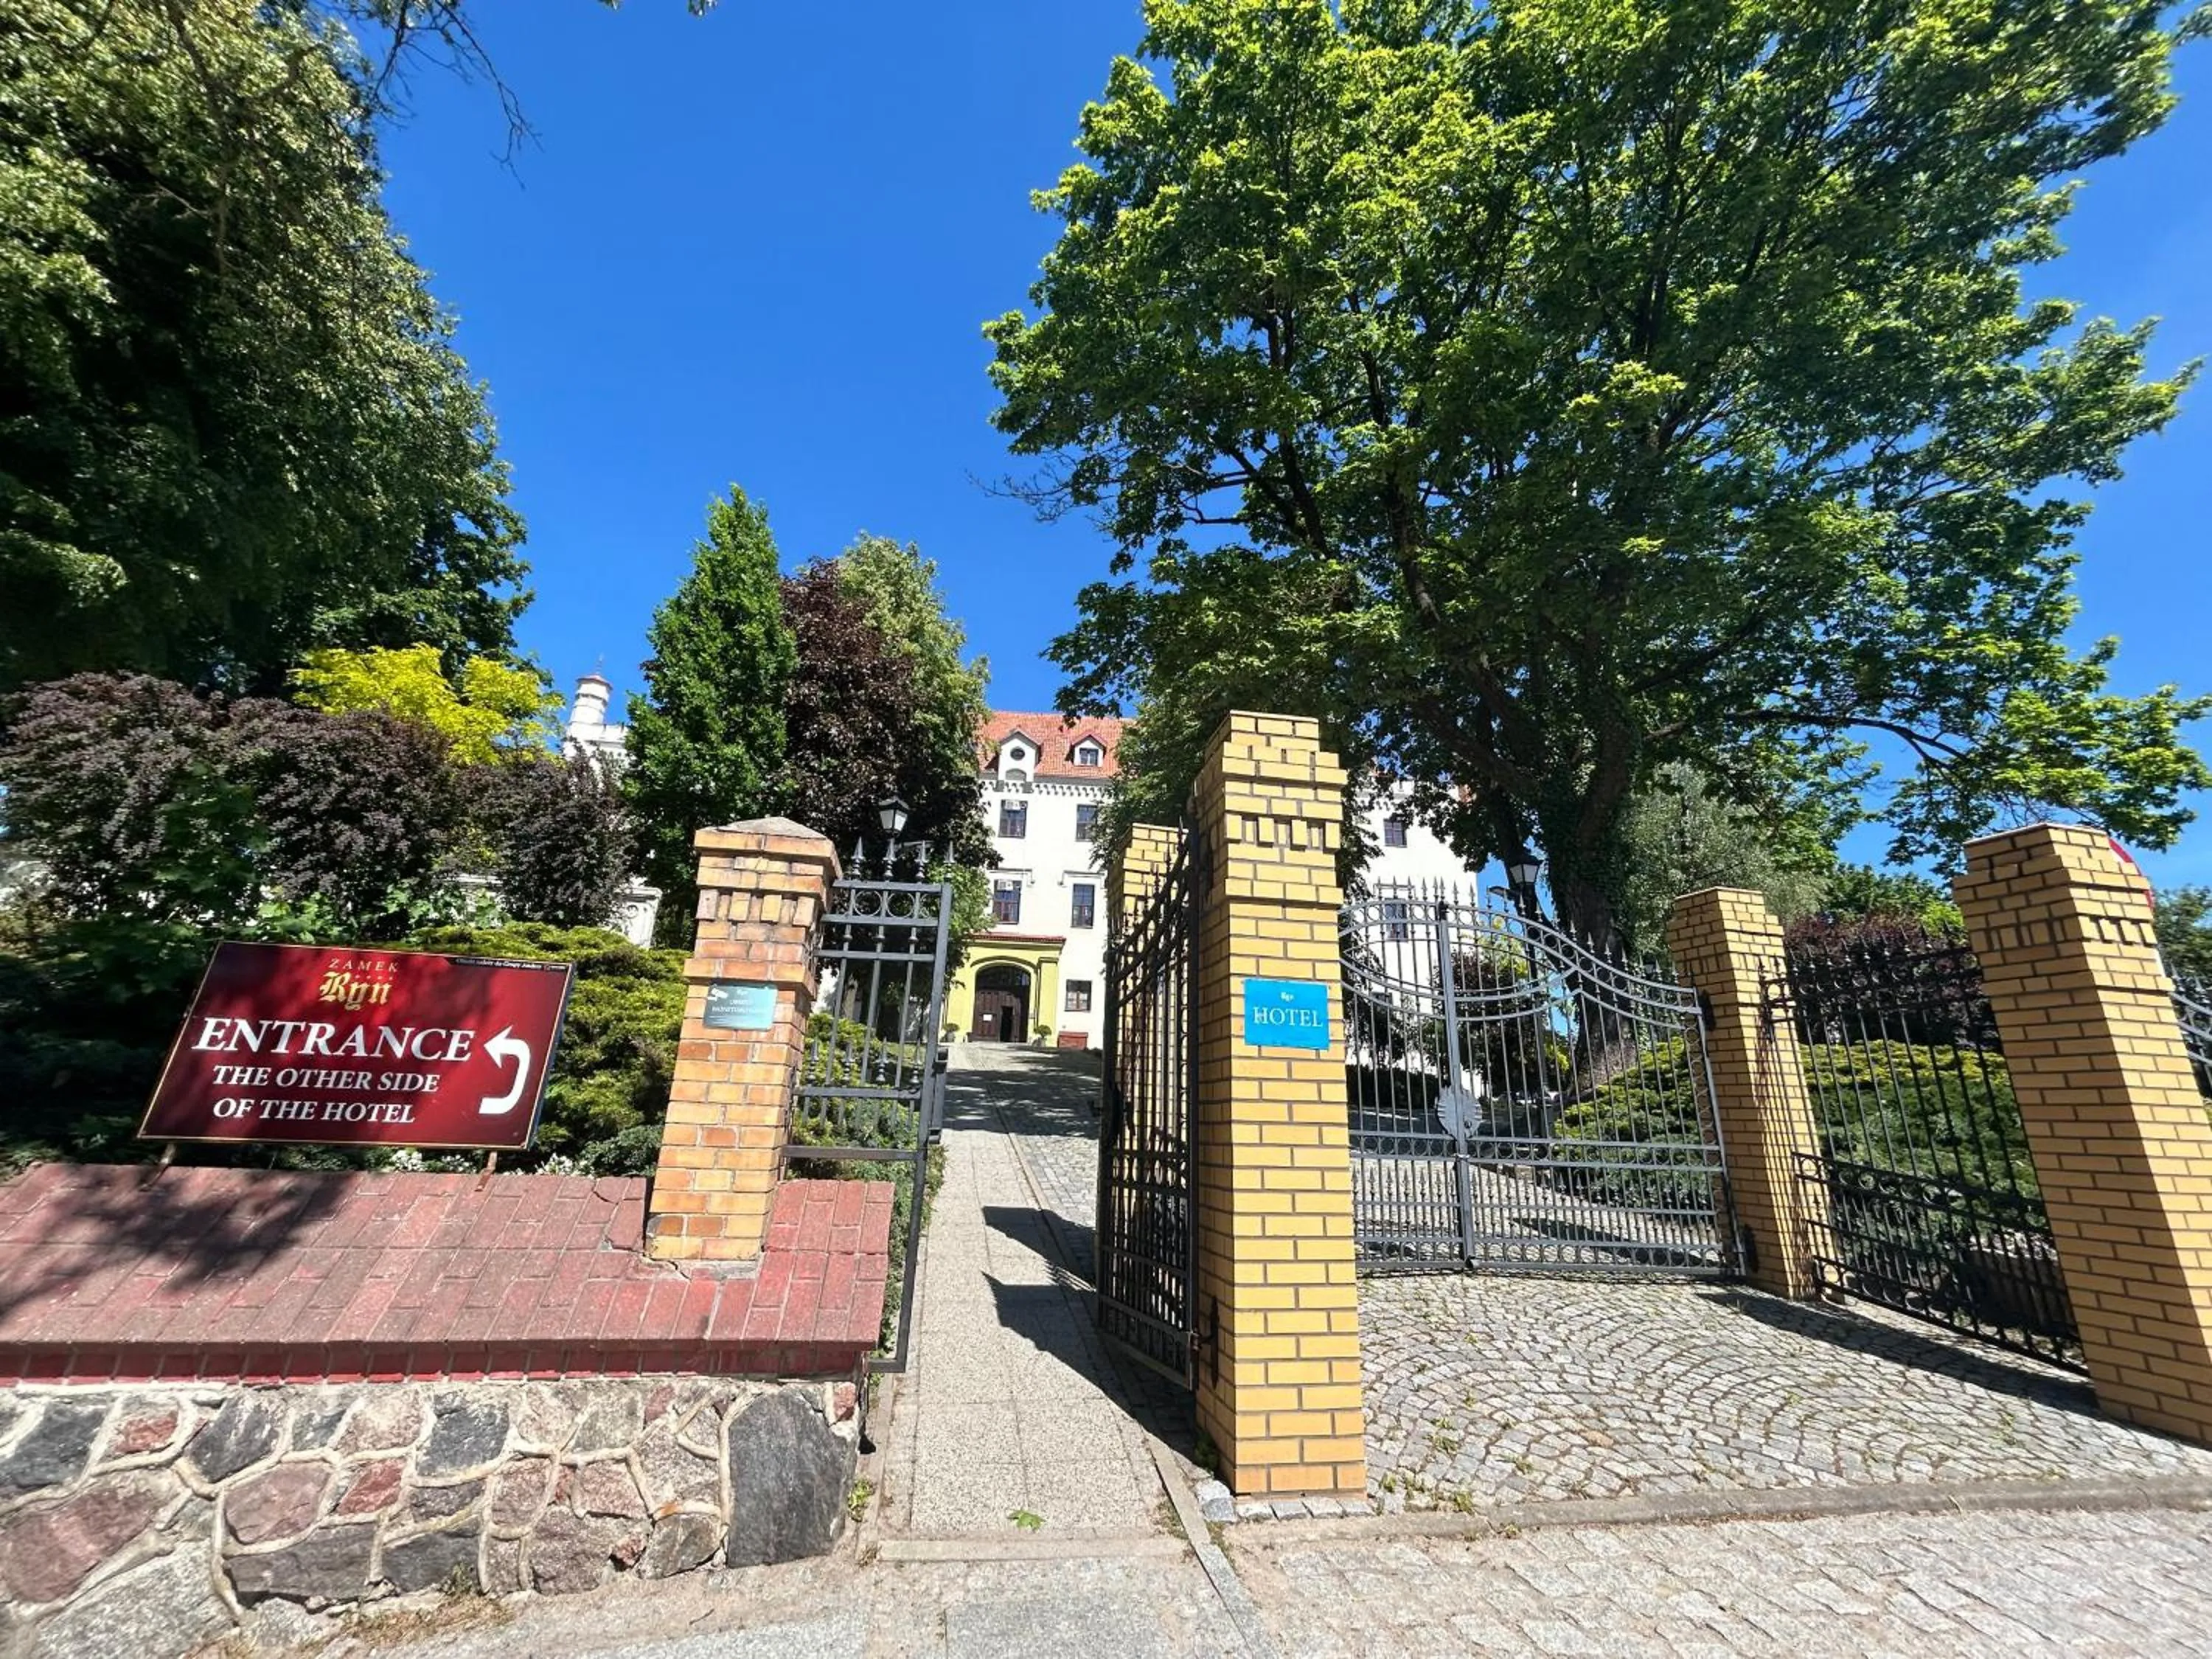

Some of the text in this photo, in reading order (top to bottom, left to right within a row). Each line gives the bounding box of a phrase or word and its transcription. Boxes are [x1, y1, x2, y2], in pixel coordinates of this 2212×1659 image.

[329, 958, 398, 972] ZAMEK
[319, 971, 392, 1011] Ryn
[1253, 1006, 1323, 1027] HOTEL
[191, 1017, 476, 1062] ENTRANCE
[212, 1065, 440, 1092] THE OTHER SIDE
[213, 1098, 416, 1123] OF THE HOTEL
